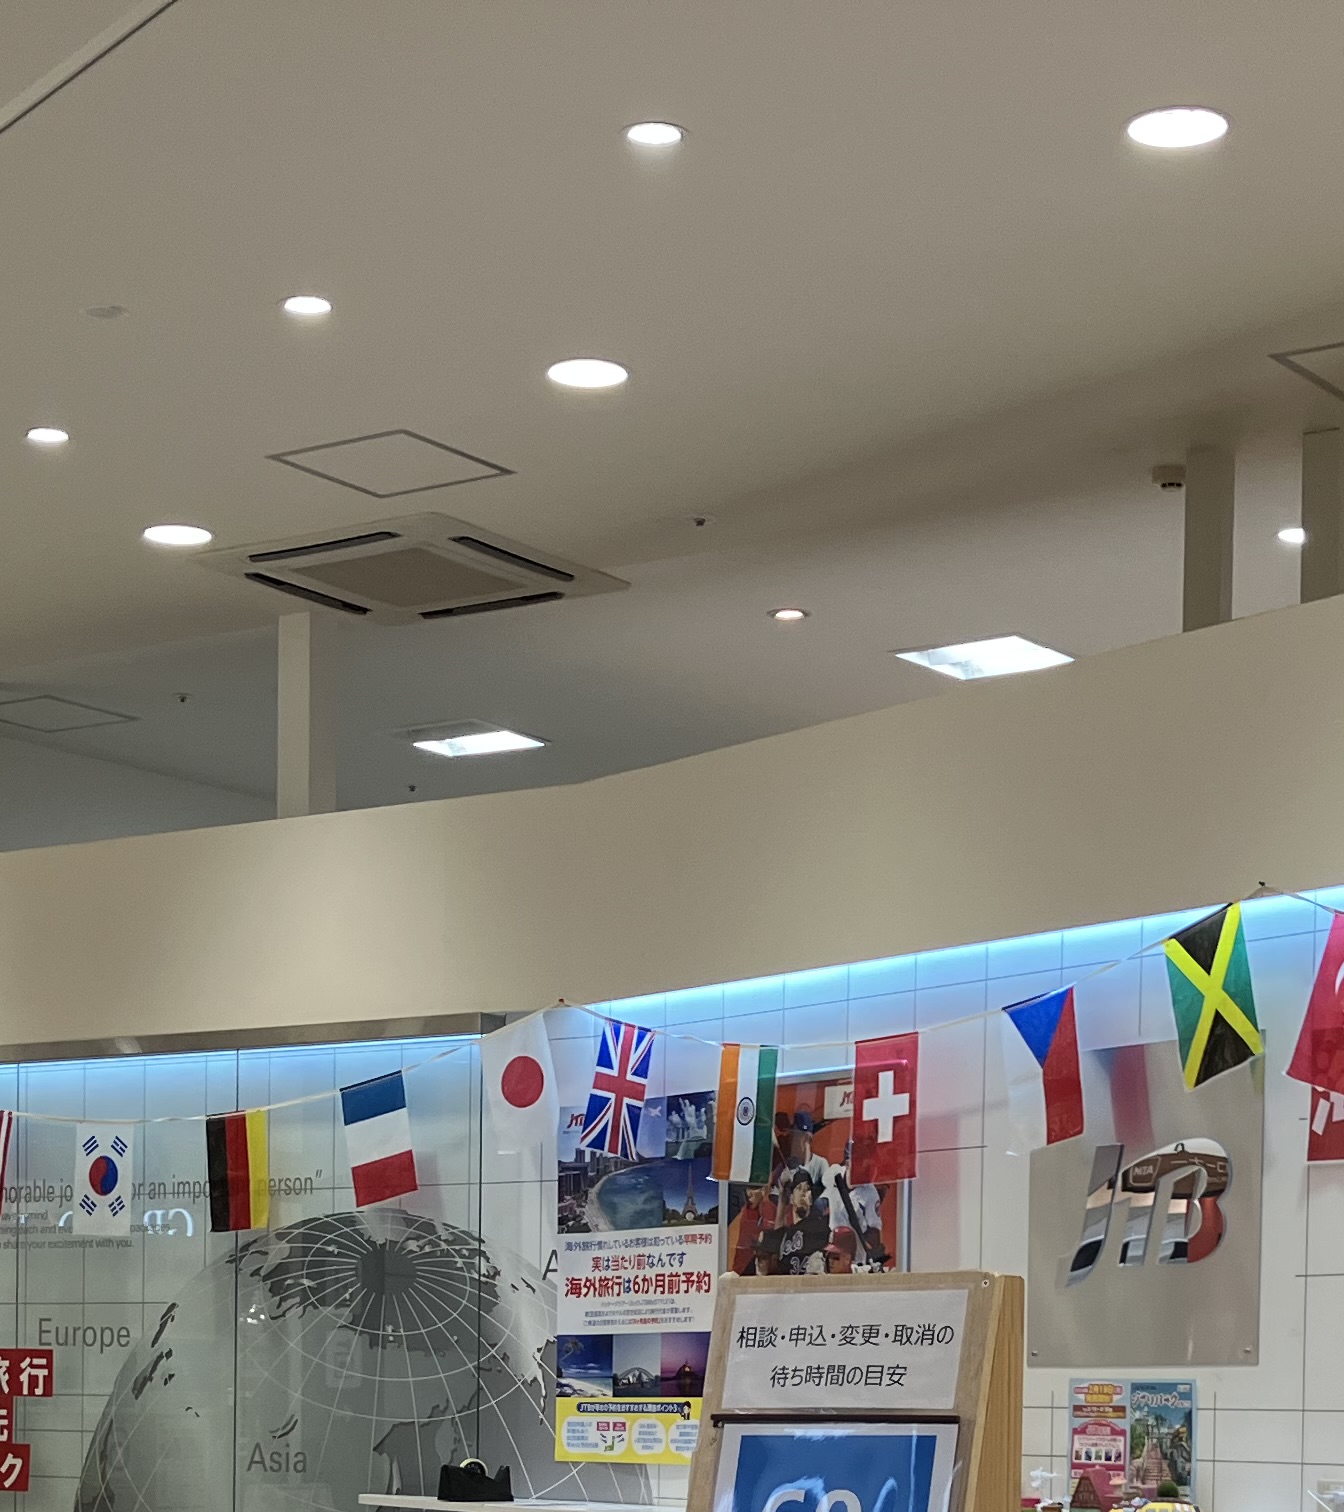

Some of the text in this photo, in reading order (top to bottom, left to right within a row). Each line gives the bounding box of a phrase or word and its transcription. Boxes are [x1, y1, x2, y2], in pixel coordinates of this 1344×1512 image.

[1064, 1136, 1233, 1288] JTB
[47, 1238, 94, 1250] excitement
[96, 1237, 115, 1249] with
[591, 1251, 687, 1272] 実は当たり前なんです
[564, 1270, 712, 1298] 海外旅行は6か月前予約
[37, 1317, 131, 1354] Europe
[736, 1323, 954, 1349] 相談・申込・変更・取消の
[769, 1363, 908, 1389] 待ち時間の目安
[246, 1444, 309, 1475] Asia
